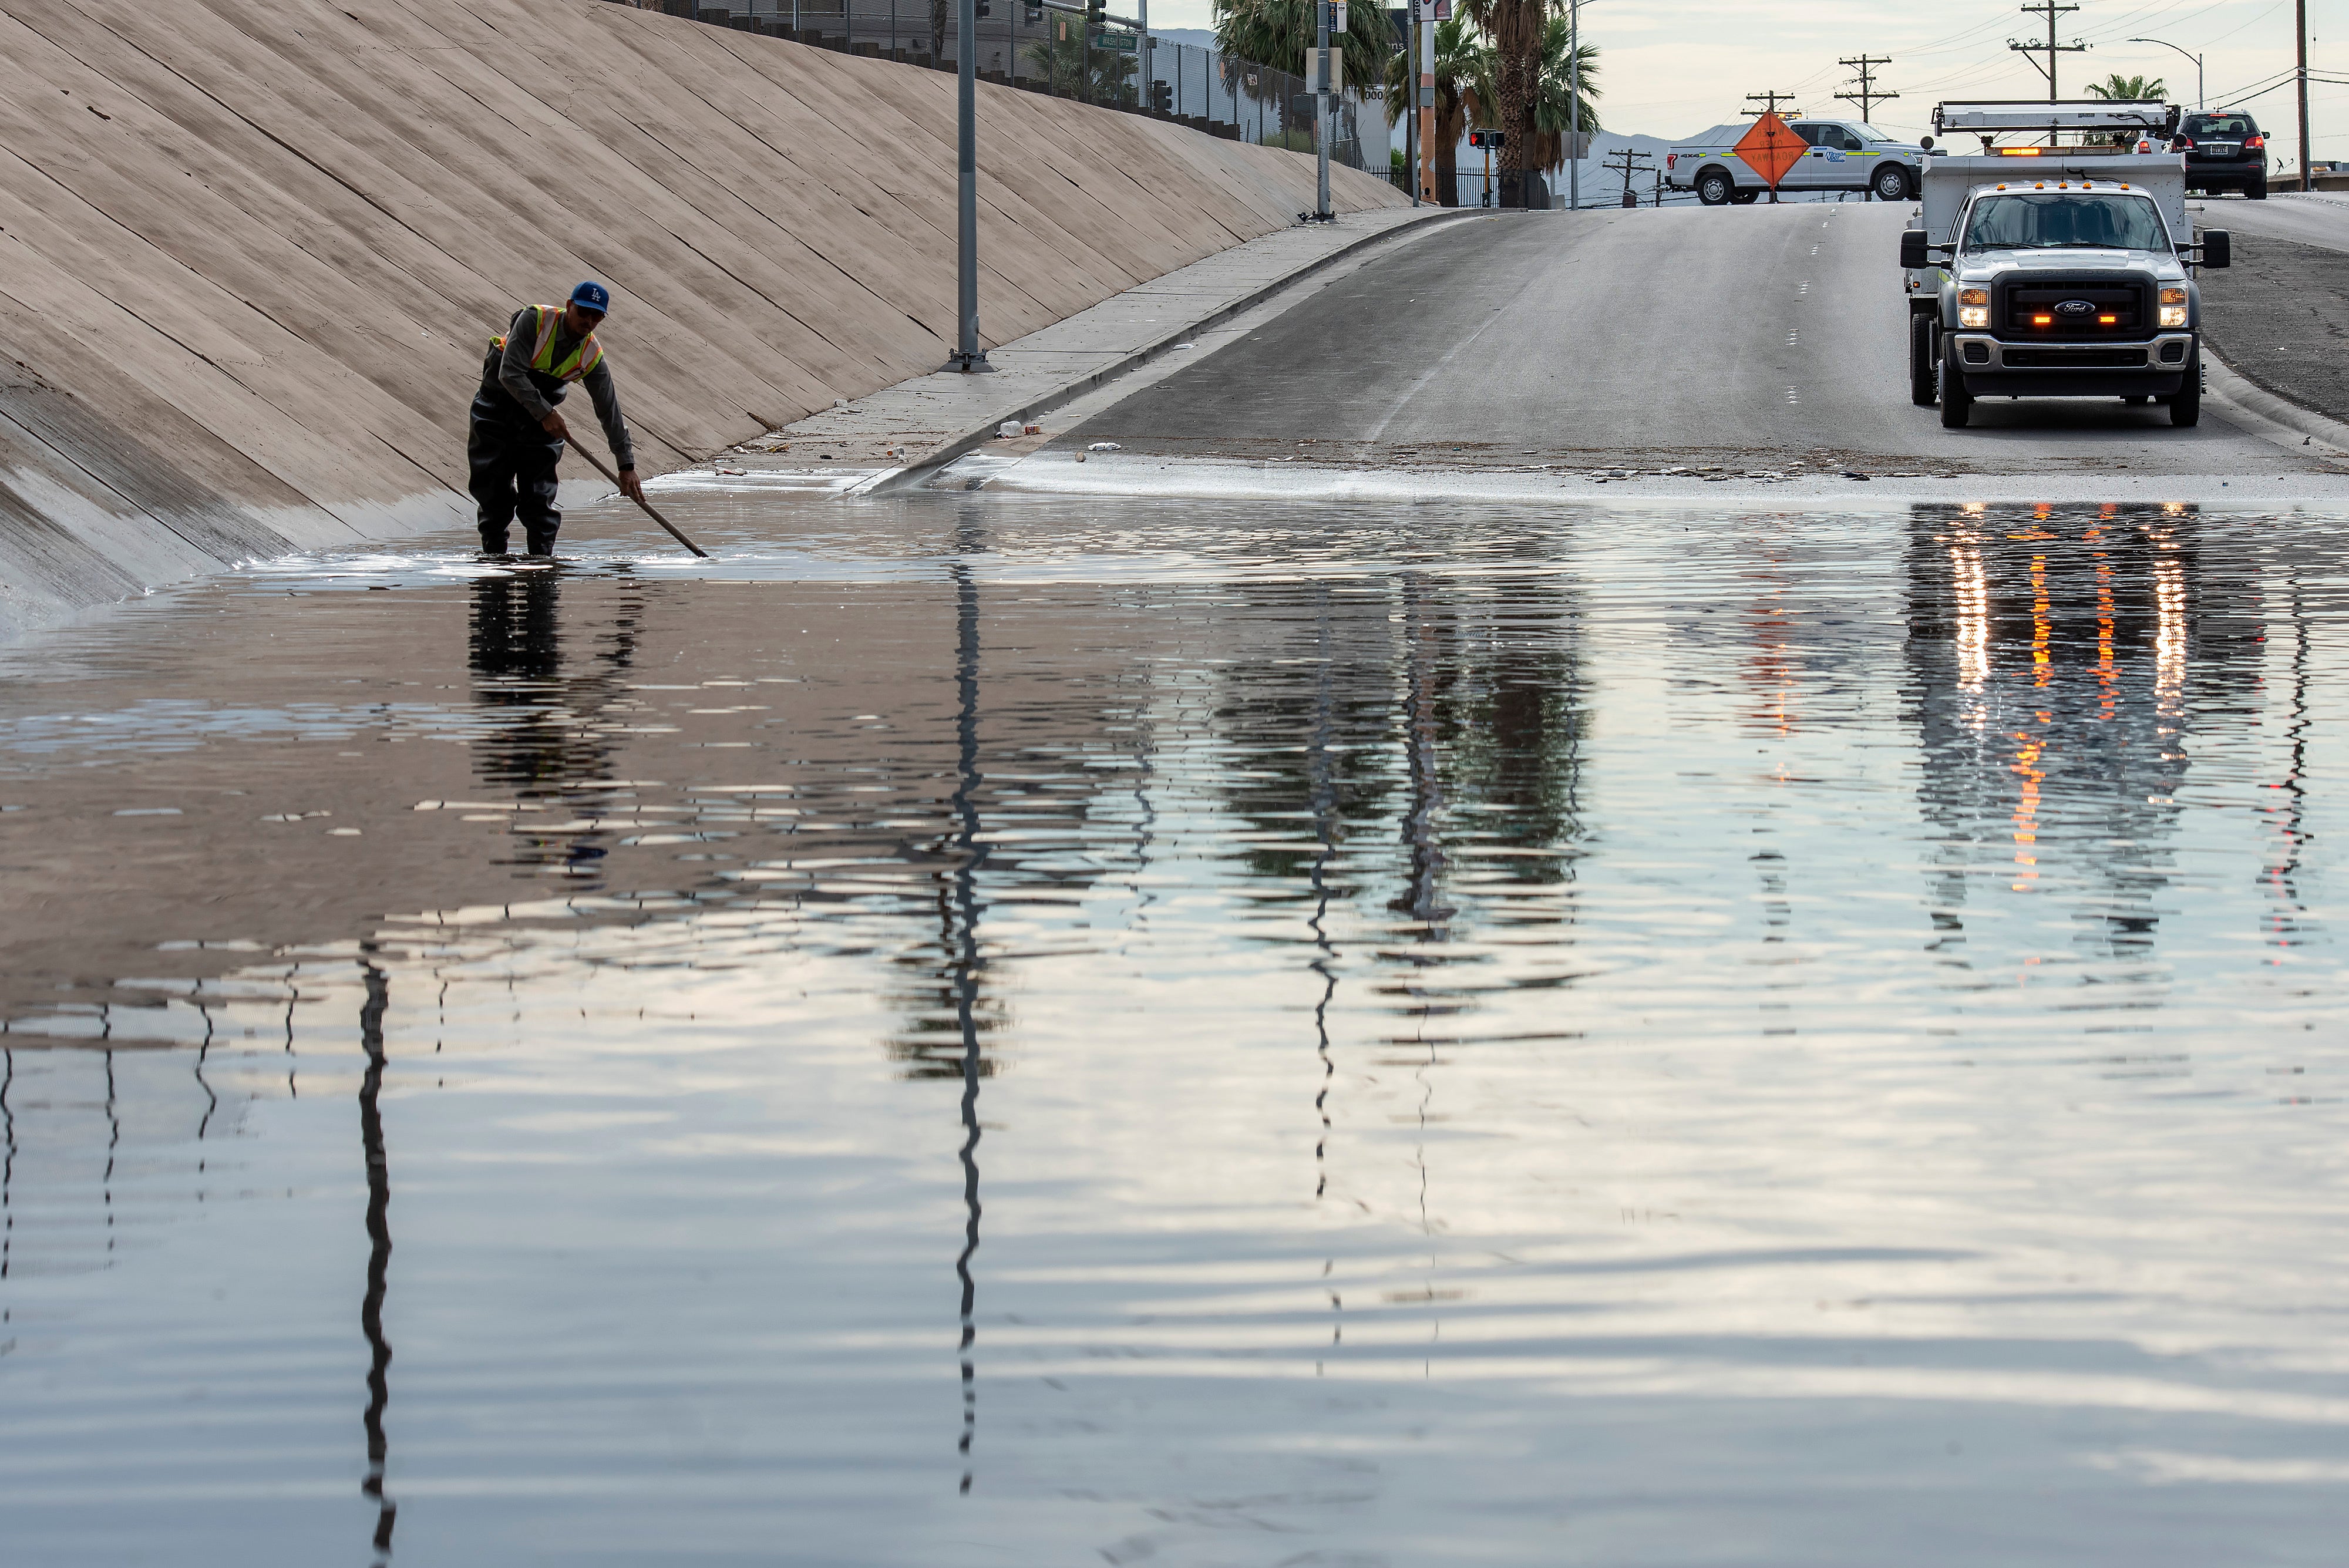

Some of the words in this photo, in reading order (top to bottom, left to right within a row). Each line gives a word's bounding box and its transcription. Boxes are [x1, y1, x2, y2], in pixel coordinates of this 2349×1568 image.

[1826, 152, 1846, 161] NEVADA
[592, 288, 601, 302] LA
[2064, 302, 2086, 312] Ford
